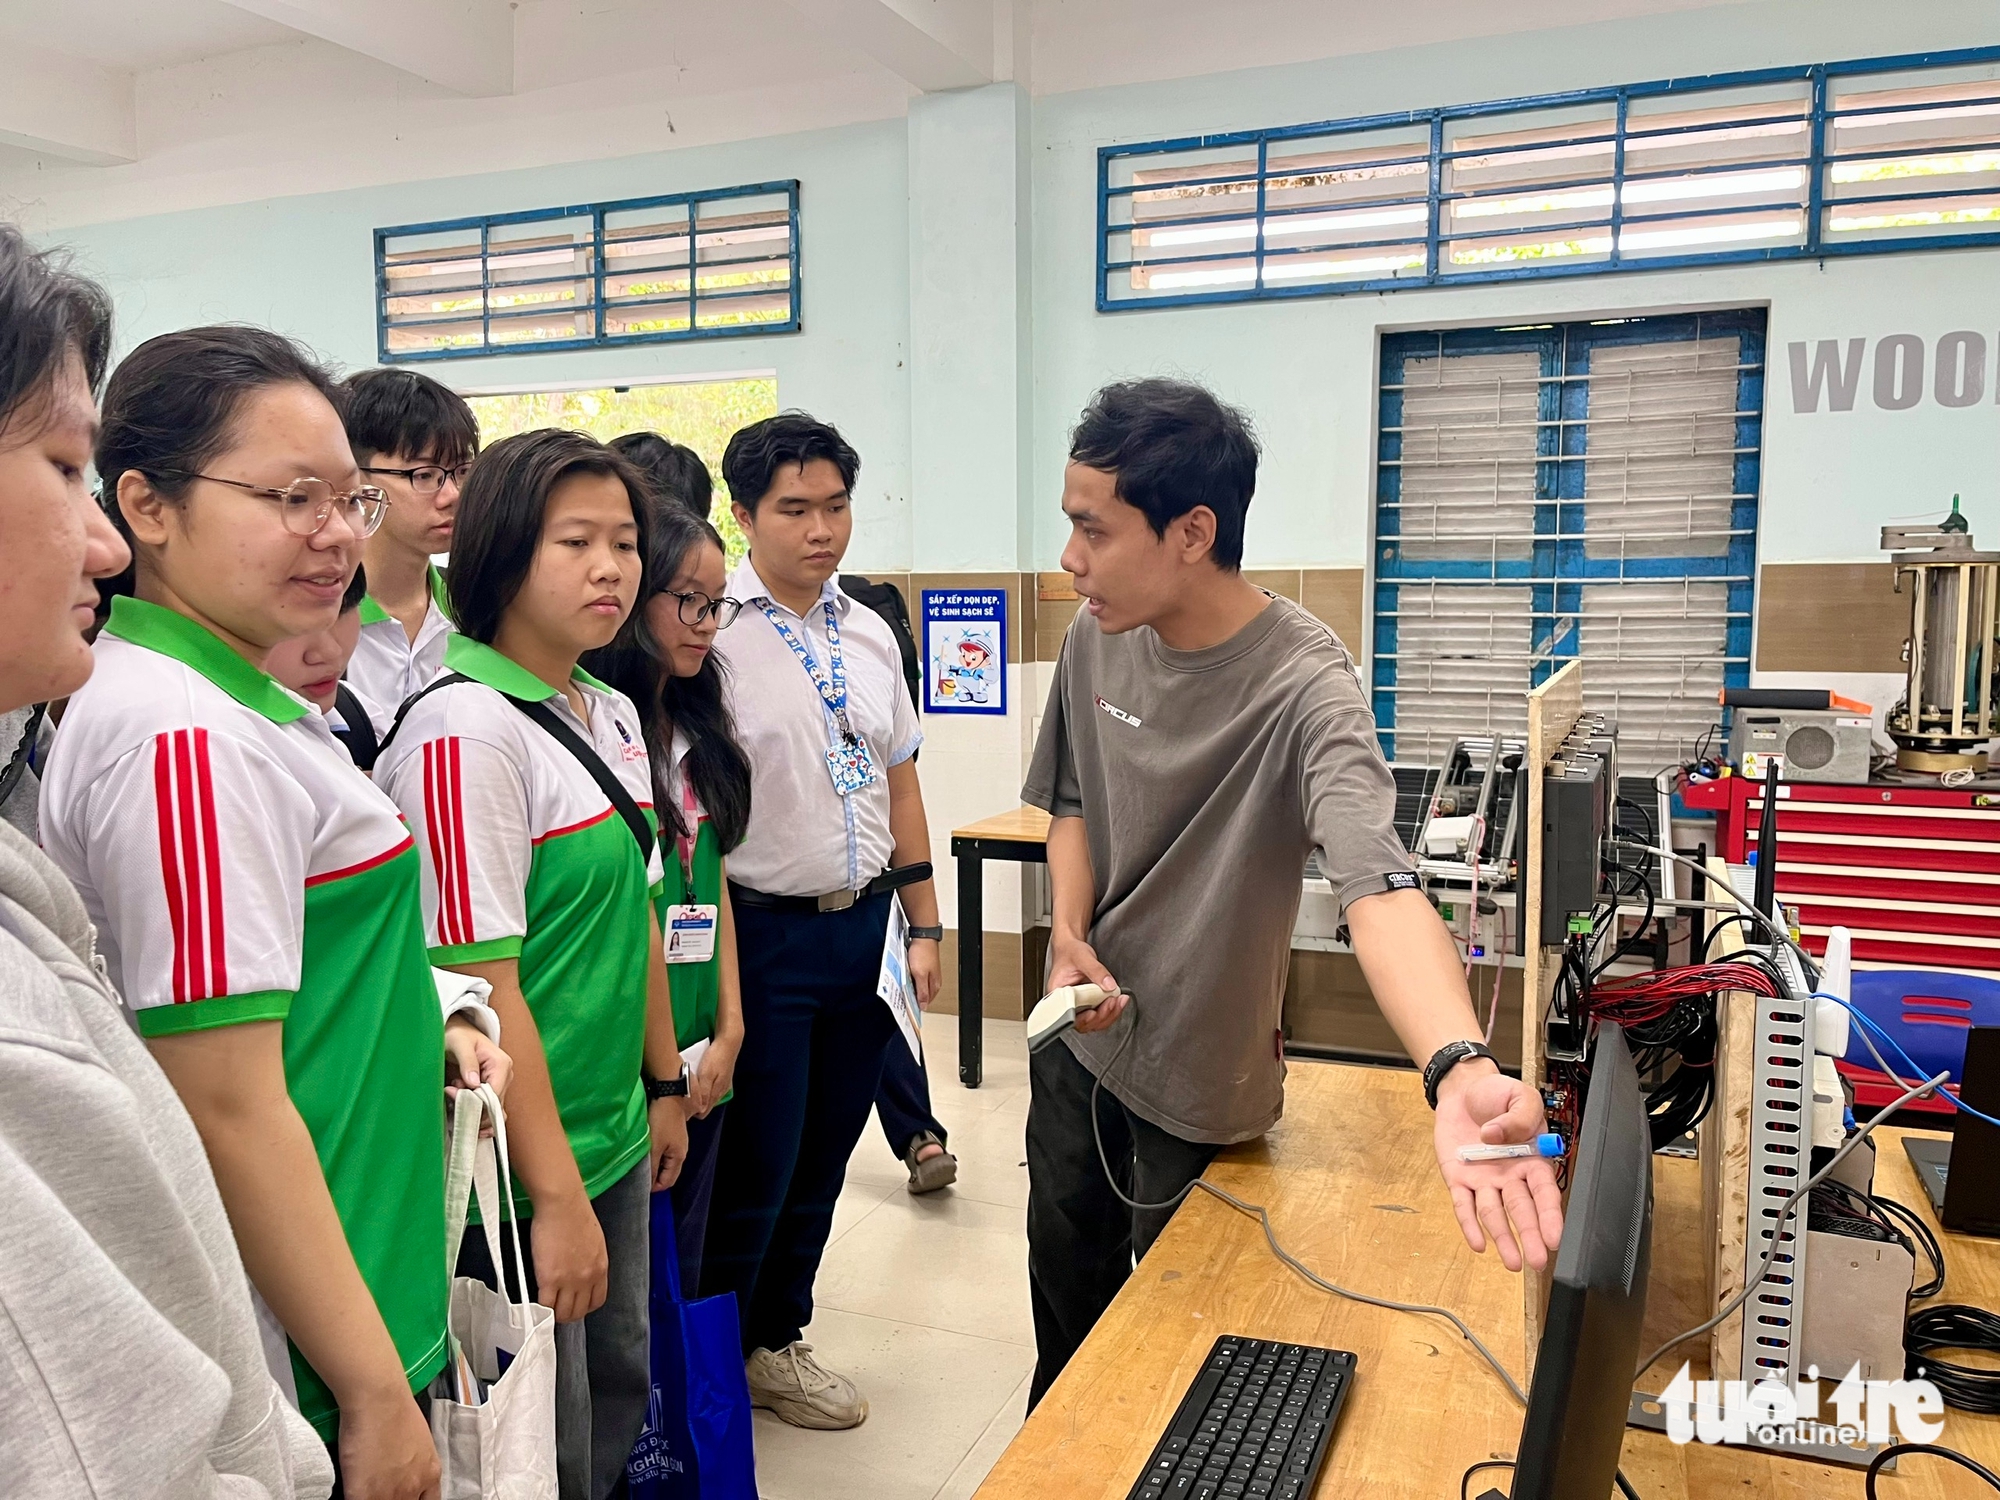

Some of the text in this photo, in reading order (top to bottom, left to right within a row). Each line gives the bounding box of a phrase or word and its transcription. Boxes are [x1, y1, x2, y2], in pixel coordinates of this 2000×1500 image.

[1787, 330, 2000, 414] WOO
[942, 607, 960, 616] SINH
[962, 607, 983, 617] SẠCH
